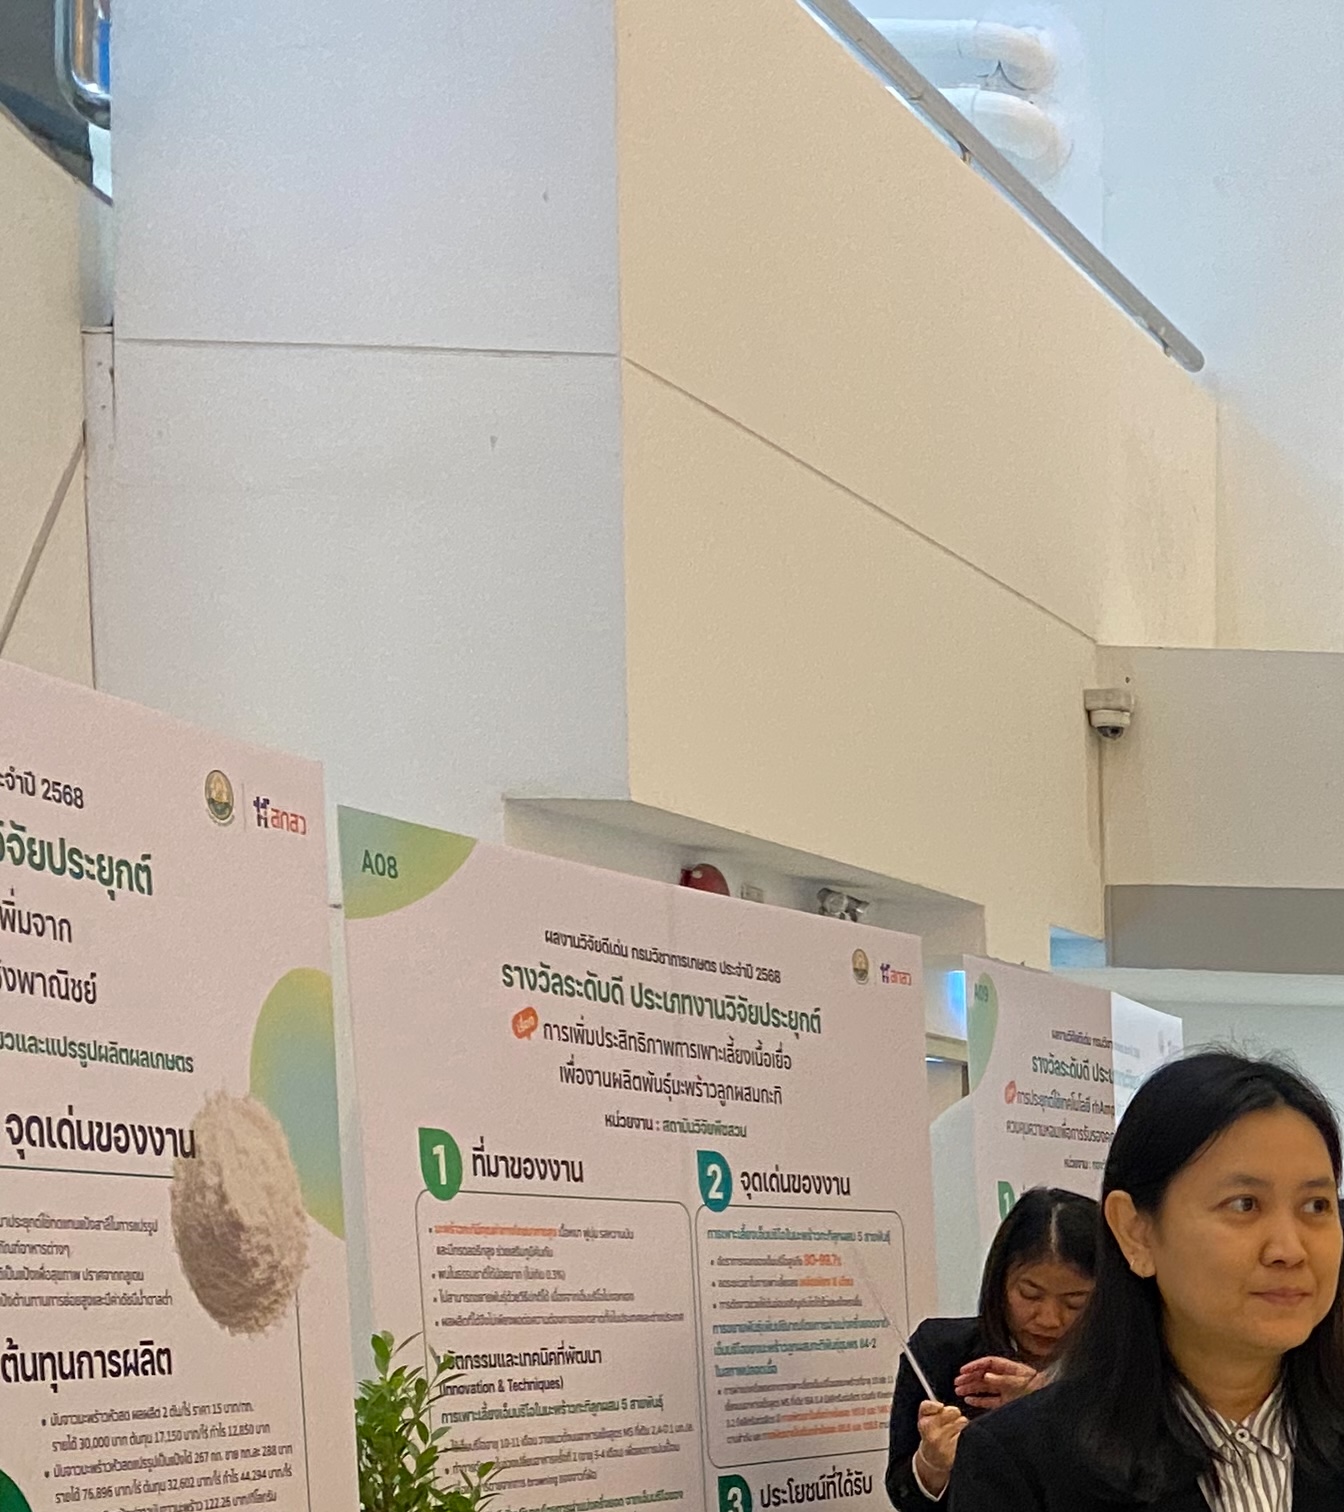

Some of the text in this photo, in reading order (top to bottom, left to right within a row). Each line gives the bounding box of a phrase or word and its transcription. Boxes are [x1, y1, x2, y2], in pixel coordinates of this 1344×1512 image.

[40, 778, 84, 809] 2568
[361, 849, 399, 879] A08
[545, 929, 782, 985] ผลงานวิจัยดีเด่น กรมวิชาการเกษตร ประจำปี 2568
[501, 961, 822, 1040] รางวัลระดับดี ประเภทงานวิจัยประยุกต์
[543, 1014, 792, 1071] การเพิ่มประสิทธิภาพการเพาะเลี้ยงเนื้อเยื่อ
[559, 1054, 783, 1107] เพื่องานผลิตพันธุ์มะพร้าวลูกผสมกะทิ
[1032, 1053, 1091, 1081] รางวัลระดับดี
[5, 1104, 197, 1159] จุดเด่นของงาน
[604, 1109, 654, 1131] หน่วยงาน
[432, 1145, 449, 1186] 1
[471, 1136, 584, 1184] ที่มาของงาน
[706, 1163, 724, 1201] 2
[740, 1164, 851, 1200] จุดเด่นของงาน
[1, 1338, 172, 1392] ต้นทุนการผลิต
[497, 1379, 506, 1393] &
[507, 1375, 564, 1394] Techniques)
[162, 1406, 168, 1418] 2
[212, 1403, 222, 1414] 15
[620, 1398, 627, 1411] 5
[79, 1436, 110, 1450] 30,000
[111, 1435, 128, 1447] บาท
[154, 1430, 181, 1443] 17,150
[760, 1465, 873, 1508] ประโยชน์ที่ได้รับ
